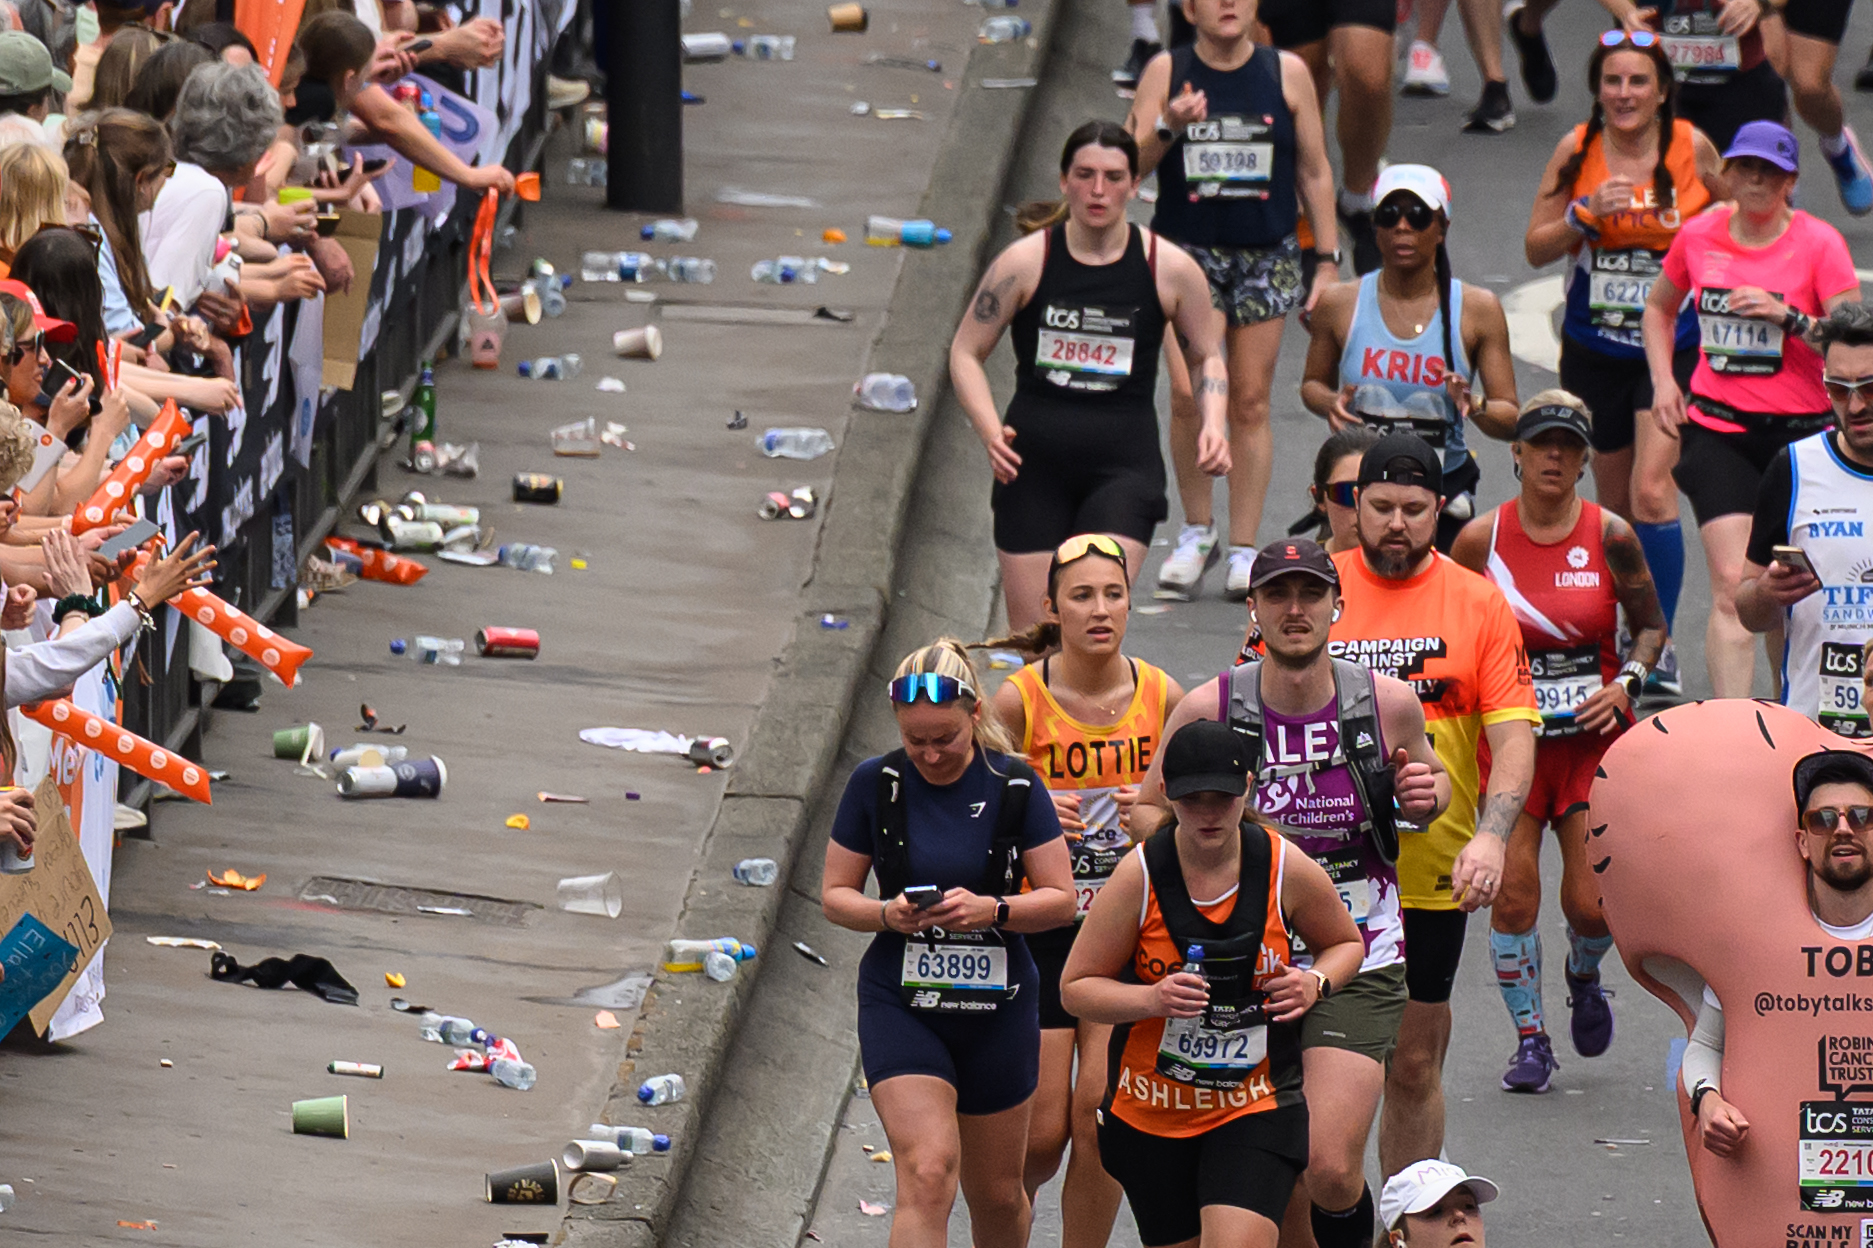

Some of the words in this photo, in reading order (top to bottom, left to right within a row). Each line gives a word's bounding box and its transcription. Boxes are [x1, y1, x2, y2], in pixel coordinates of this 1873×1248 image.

[1046, 305, 1080, 329] tcs
[1052, 339, 1117, 367] 28842
[1362, 347, 1445, 385] KRIS
[1809, 521, 1864, 538] RYAN
[1555, 572, 1600, 588] LONDON
[1328, 637, 1441, 656] CAMPAIGN
[1826, 651, 1858, 672] tcs
[1049, 736, 1152, 778] LOTTIE
[1296, 794, 1355, 810] National
[1288, 810, 1355, 824] Children's
[918, 954, 991, 980] 63899
[960, 1000, 997, 1010] balance
[1829, 1067, 1873, 1081] TRUST
[1118, 1066, 1271, 1110] ASHLEIGH
[1806, 1108, 1847, 1134] tcs
[1845, 1200, 1864, 1208] new
[1786, 1224, 1828, 1239] SCAN
[1831, 1225, 1853, 1240] MY
